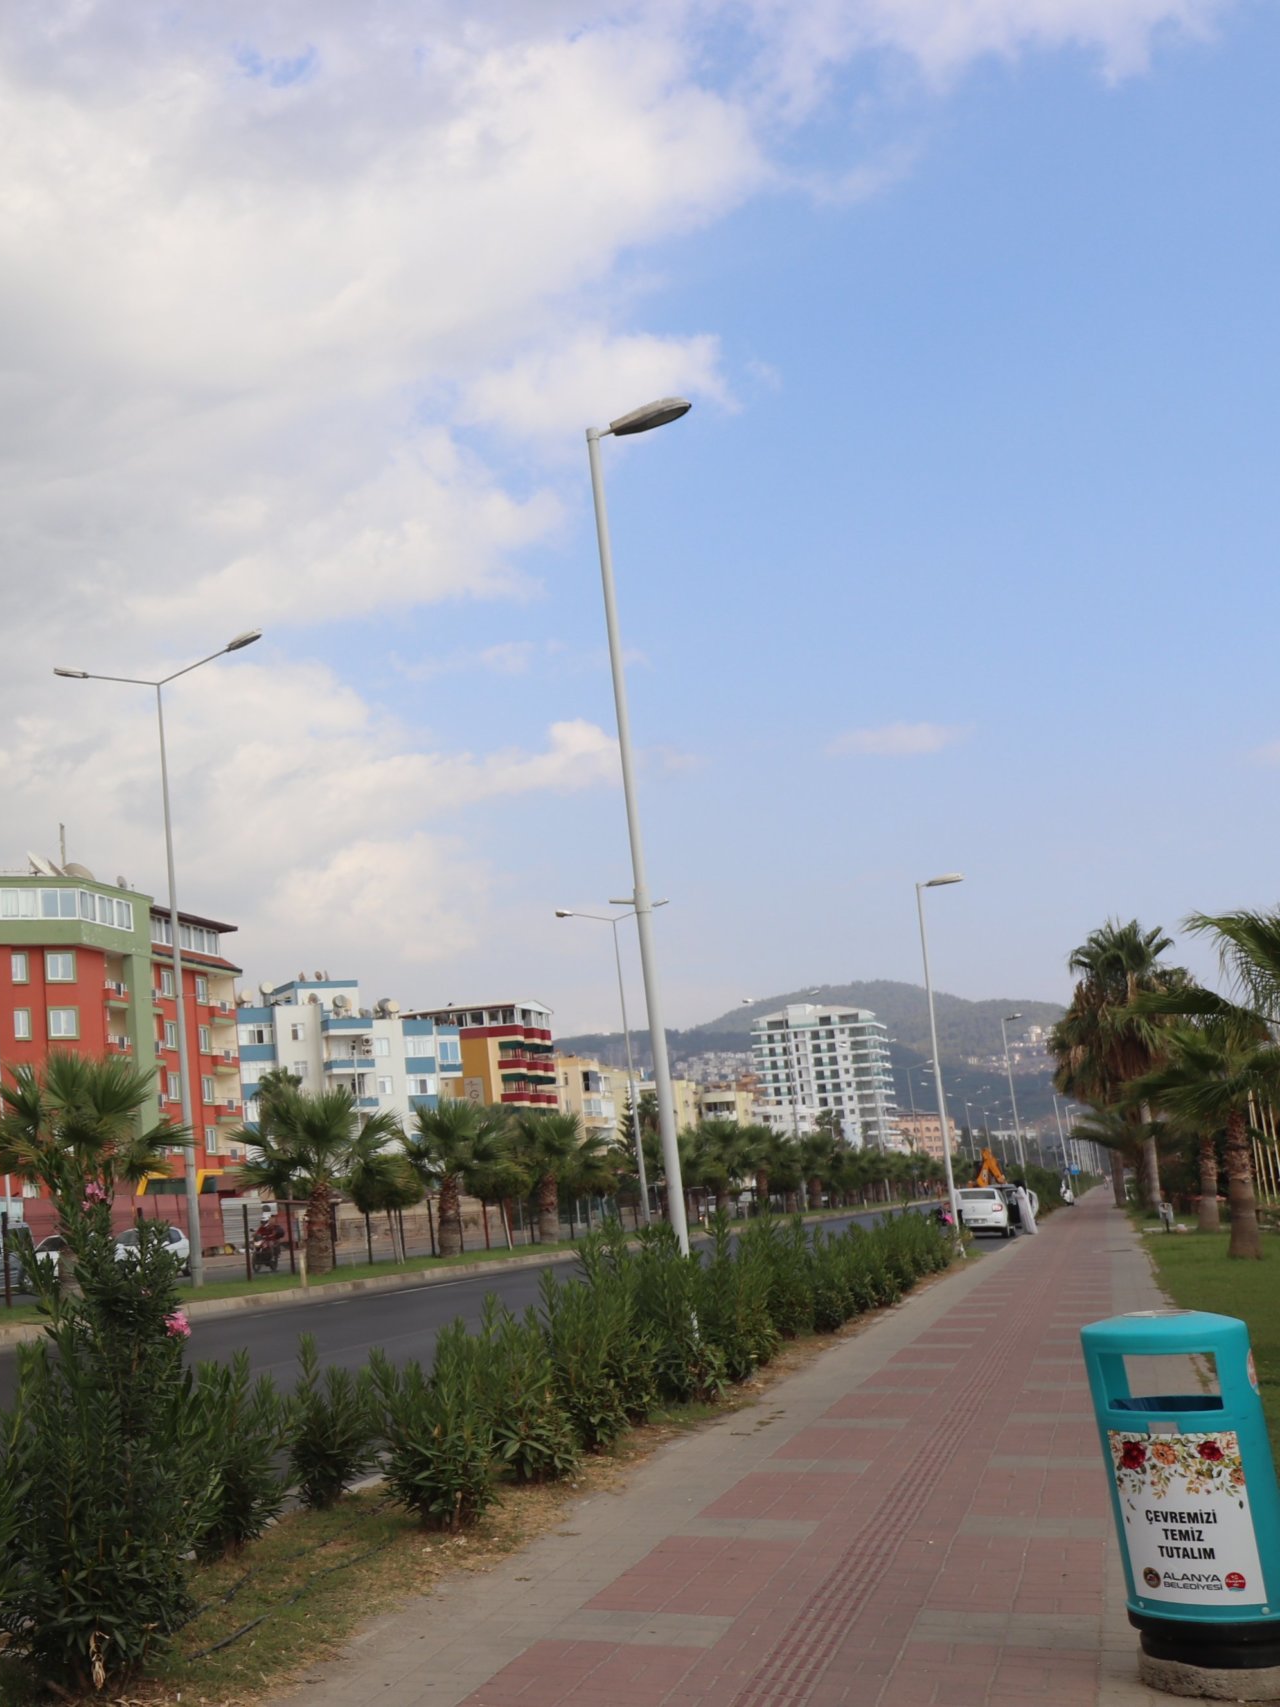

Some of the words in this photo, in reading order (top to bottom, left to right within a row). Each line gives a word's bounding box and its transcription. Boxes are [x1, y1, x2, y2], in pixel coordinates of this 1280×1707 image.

[1145, 1509, 1218, 1525] ÇEVREMİZİ
[1162, 1527, 1205, 1542] TEMİZ
[1157, 1545, 1216, 1560] TUTALIM
[1163, 1572, 1221, 1582] ALANYA
[1163, 1581, 1223, 1591] BELEDİYESİ
